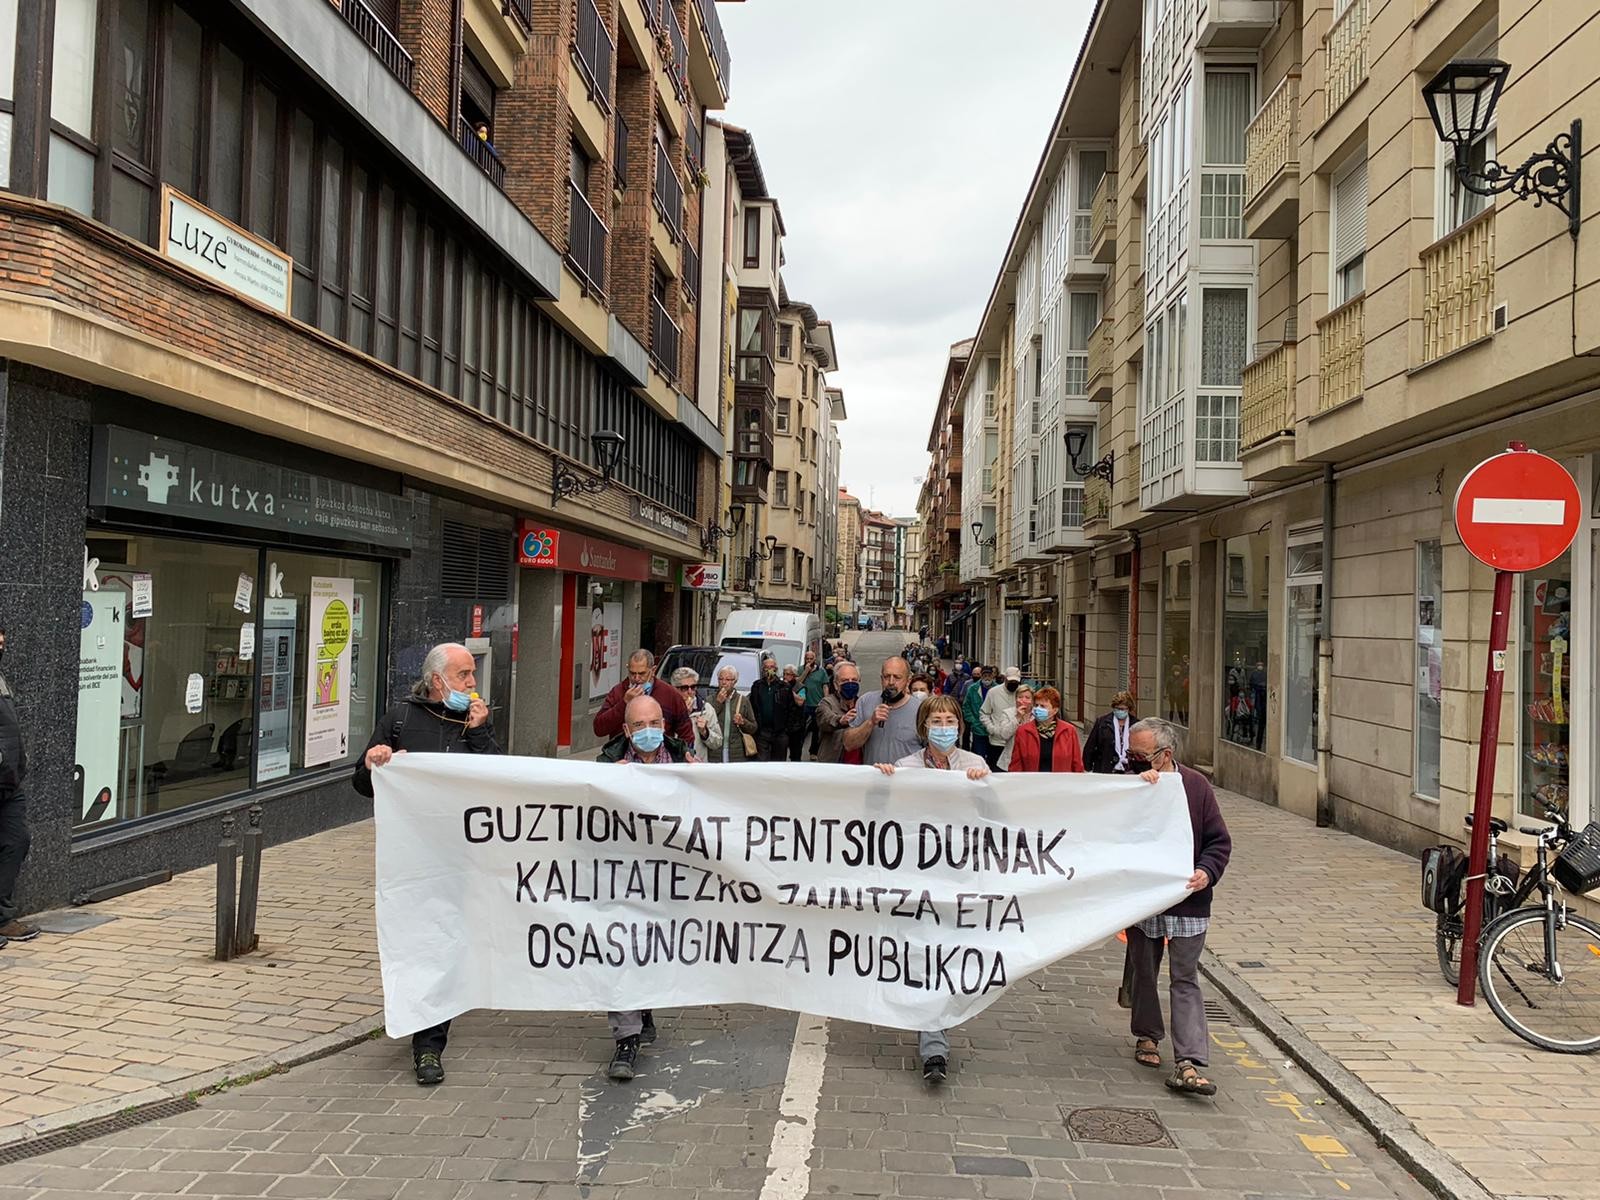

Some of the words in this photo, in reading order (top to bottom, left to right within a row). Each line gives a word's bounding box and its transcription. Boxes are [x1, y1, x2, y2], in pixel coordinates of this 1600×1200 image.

[168, 200, 228, 270] Luze
[189, 467, 275, 516] kutxa
[537, 557, 554, 565] 6000
[589, 546, 616, 571] Santander
[463, 803, 730, 861] GUZTIONTZAT
[745, 815, 903, 871] PENTSIO
[917, 821, 1075, 881] DUINAK,
[956, 892, 1025, 933] ETA
[527, 917, 811, 973] OSASUNGINTZA
[828, 928, 1008, 996] PUBLIKOA
